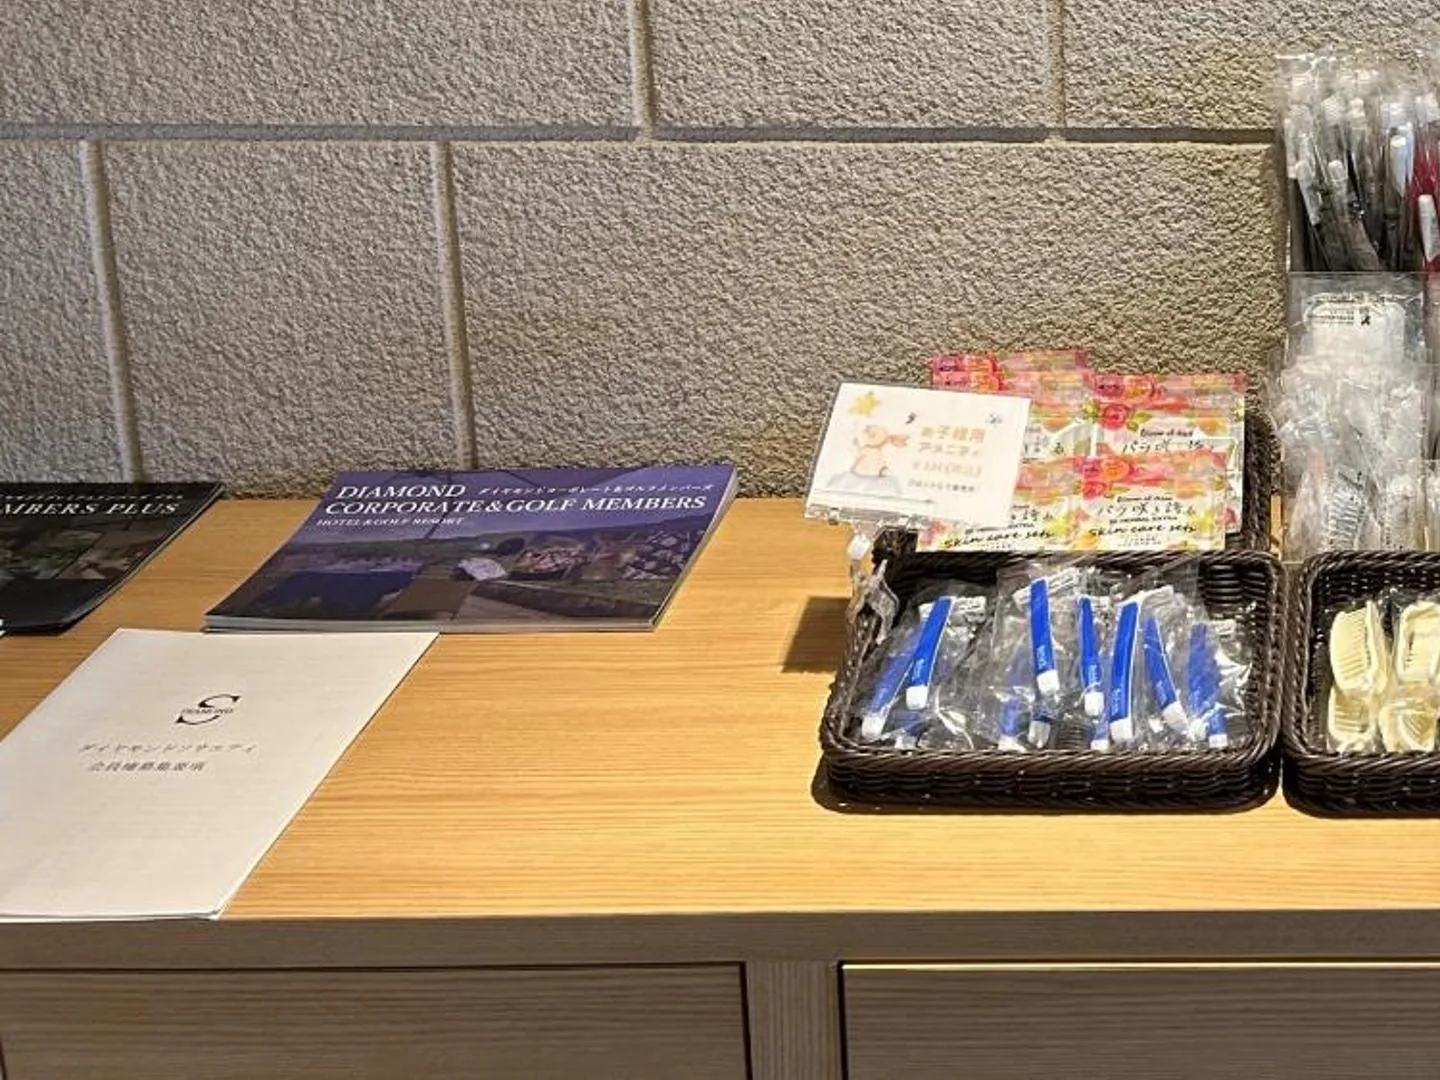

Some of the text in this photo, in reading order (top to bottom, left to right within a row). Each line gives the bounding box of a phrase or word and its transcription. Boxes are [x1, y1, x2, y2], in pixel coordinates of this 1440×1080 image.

[335, 483, 467, 500] DIAMOND
[105, 503, 181, 515] PLUS
[580, 495, 707, 511] MEMBERS
